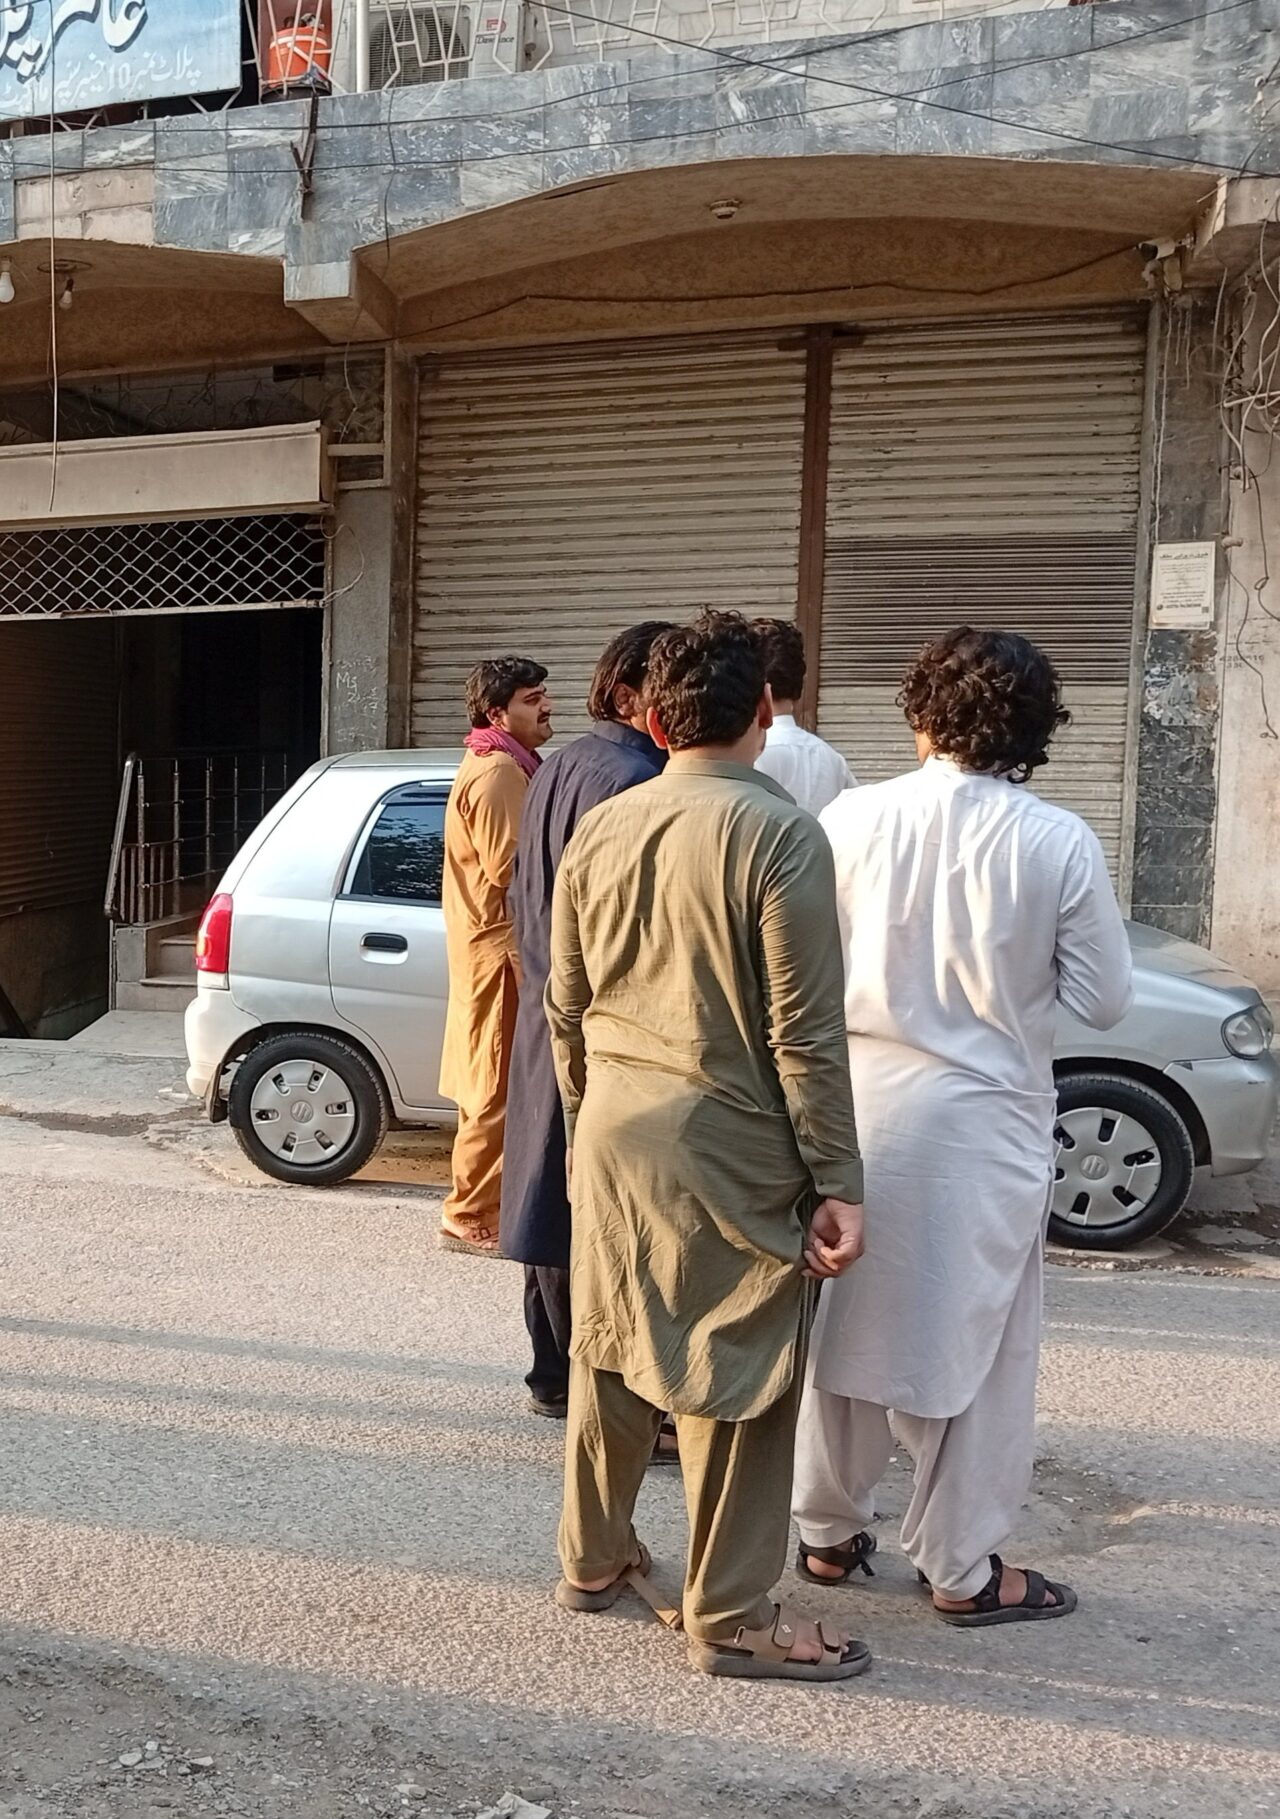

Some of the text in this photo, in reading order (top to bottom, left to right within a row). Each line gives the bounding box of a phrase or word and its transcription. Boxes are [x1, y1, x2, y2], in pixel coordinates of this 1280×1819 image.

[70, 52, 106, 105] خیبر
[107, 61, 131, 93] 10
[128, 50, 158, 95] نمبر
[151, 43, 203, 87] پلاٹ
